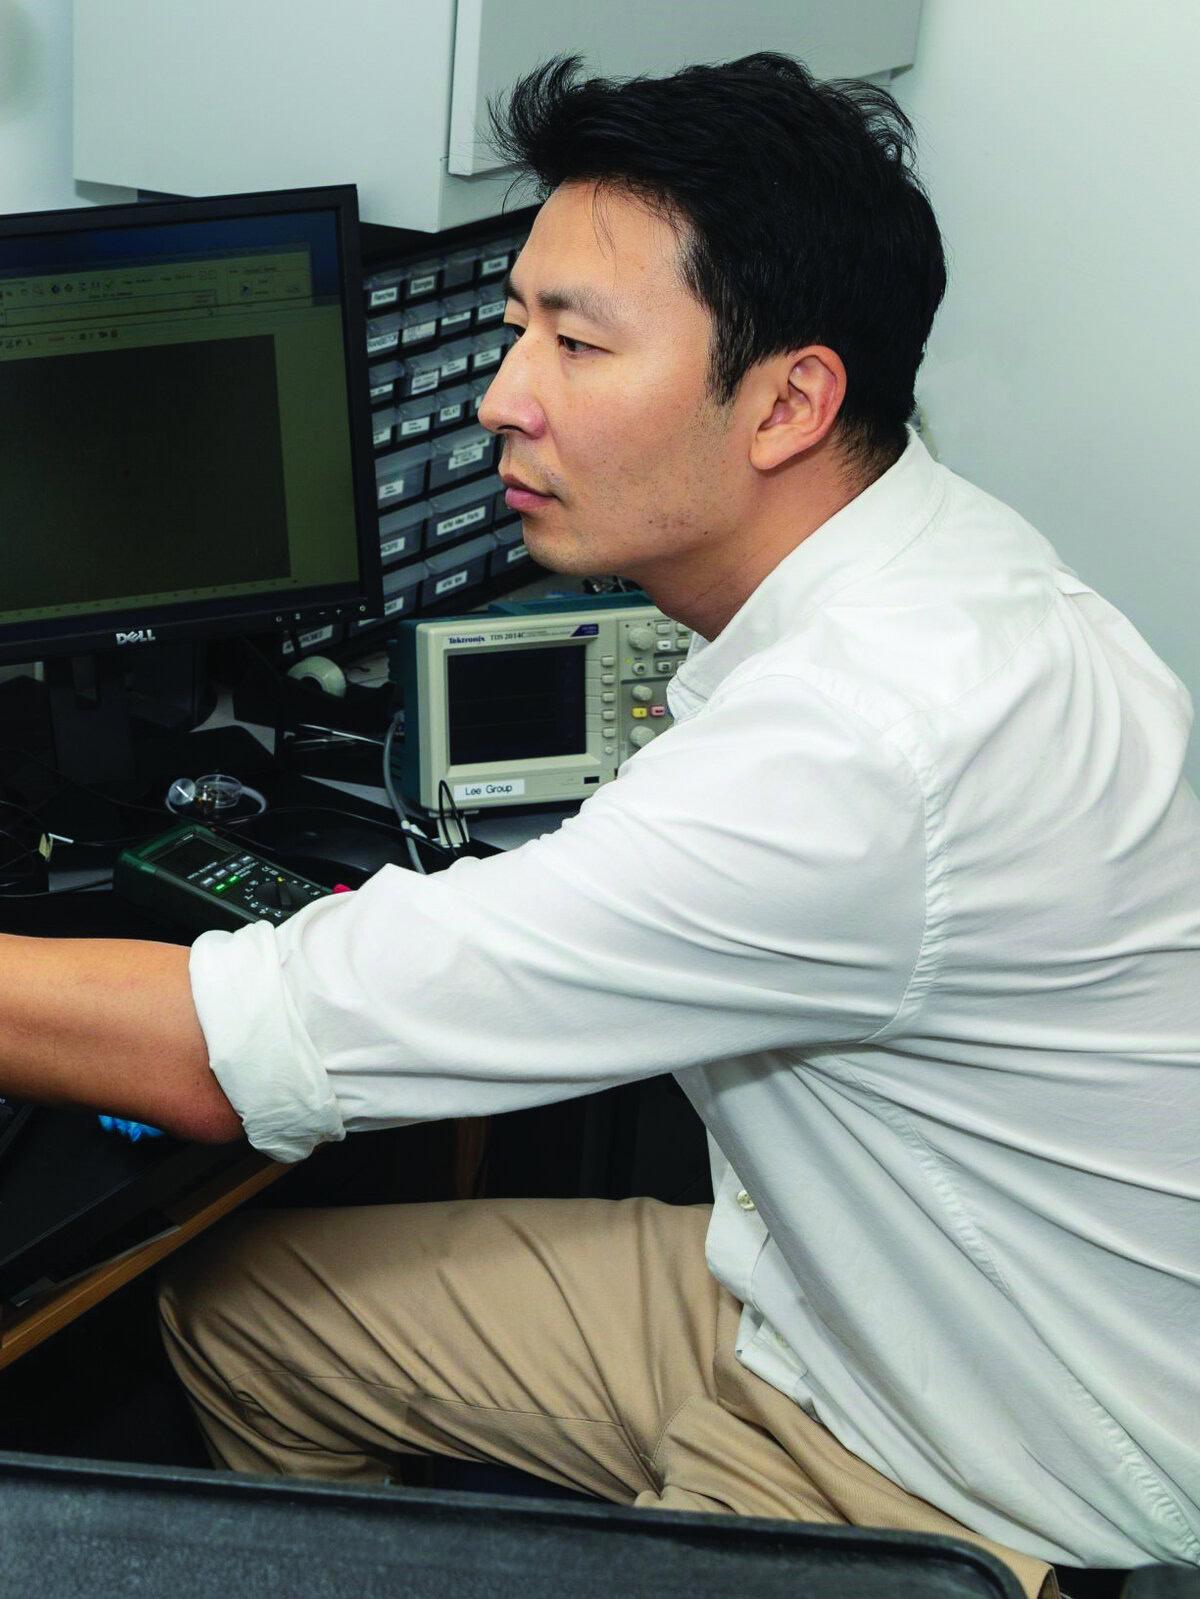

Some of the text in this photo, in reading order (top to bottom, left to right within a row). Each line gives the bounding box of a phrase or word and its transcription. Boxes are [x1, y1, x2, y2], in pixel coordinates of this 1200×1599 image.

[116, 629, 156, 645] DELL
[449, 635, 486, 645] Tektronix
[486, 784, 512, 794] Group
